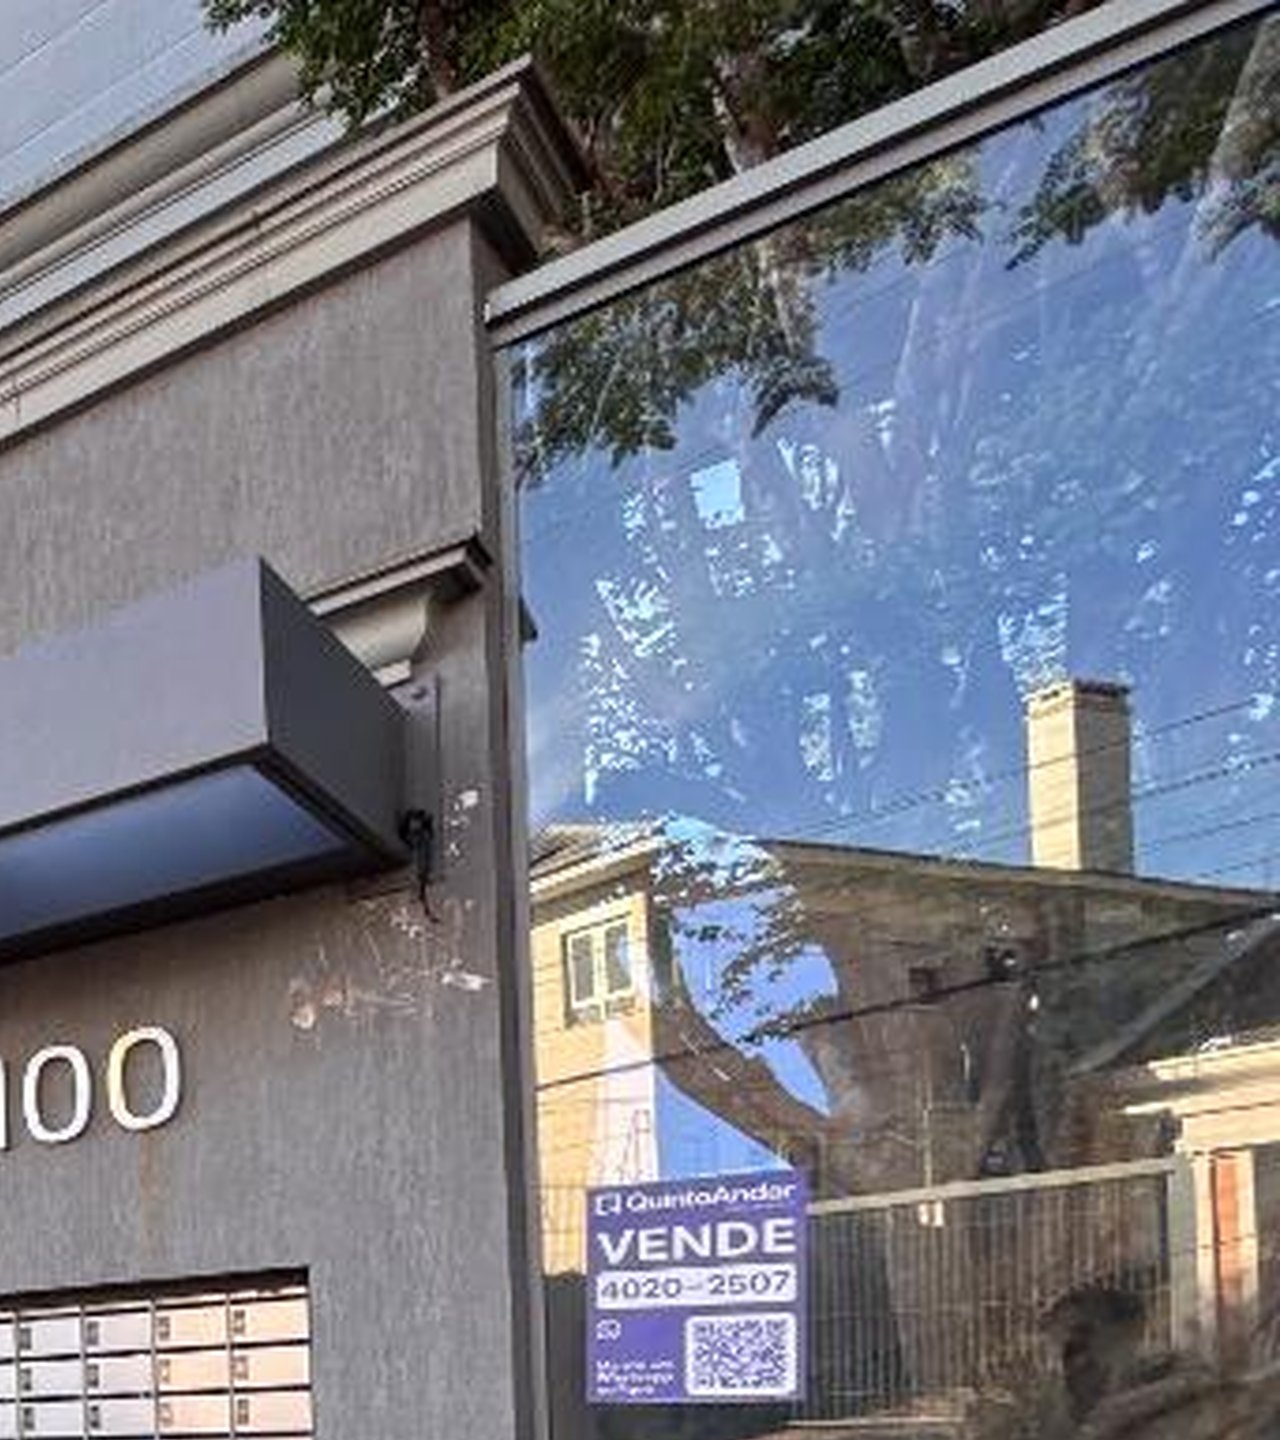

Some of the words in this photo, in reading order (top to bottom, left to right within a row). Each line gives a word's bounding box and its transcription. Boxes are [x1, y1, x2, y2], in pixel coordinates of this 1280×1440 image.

[625, 1182, 797, 1212] QuintoAndar
[597, 1217, 798, 1265] VENDE
[600, 1270, 791, 1299] 4020-2507
